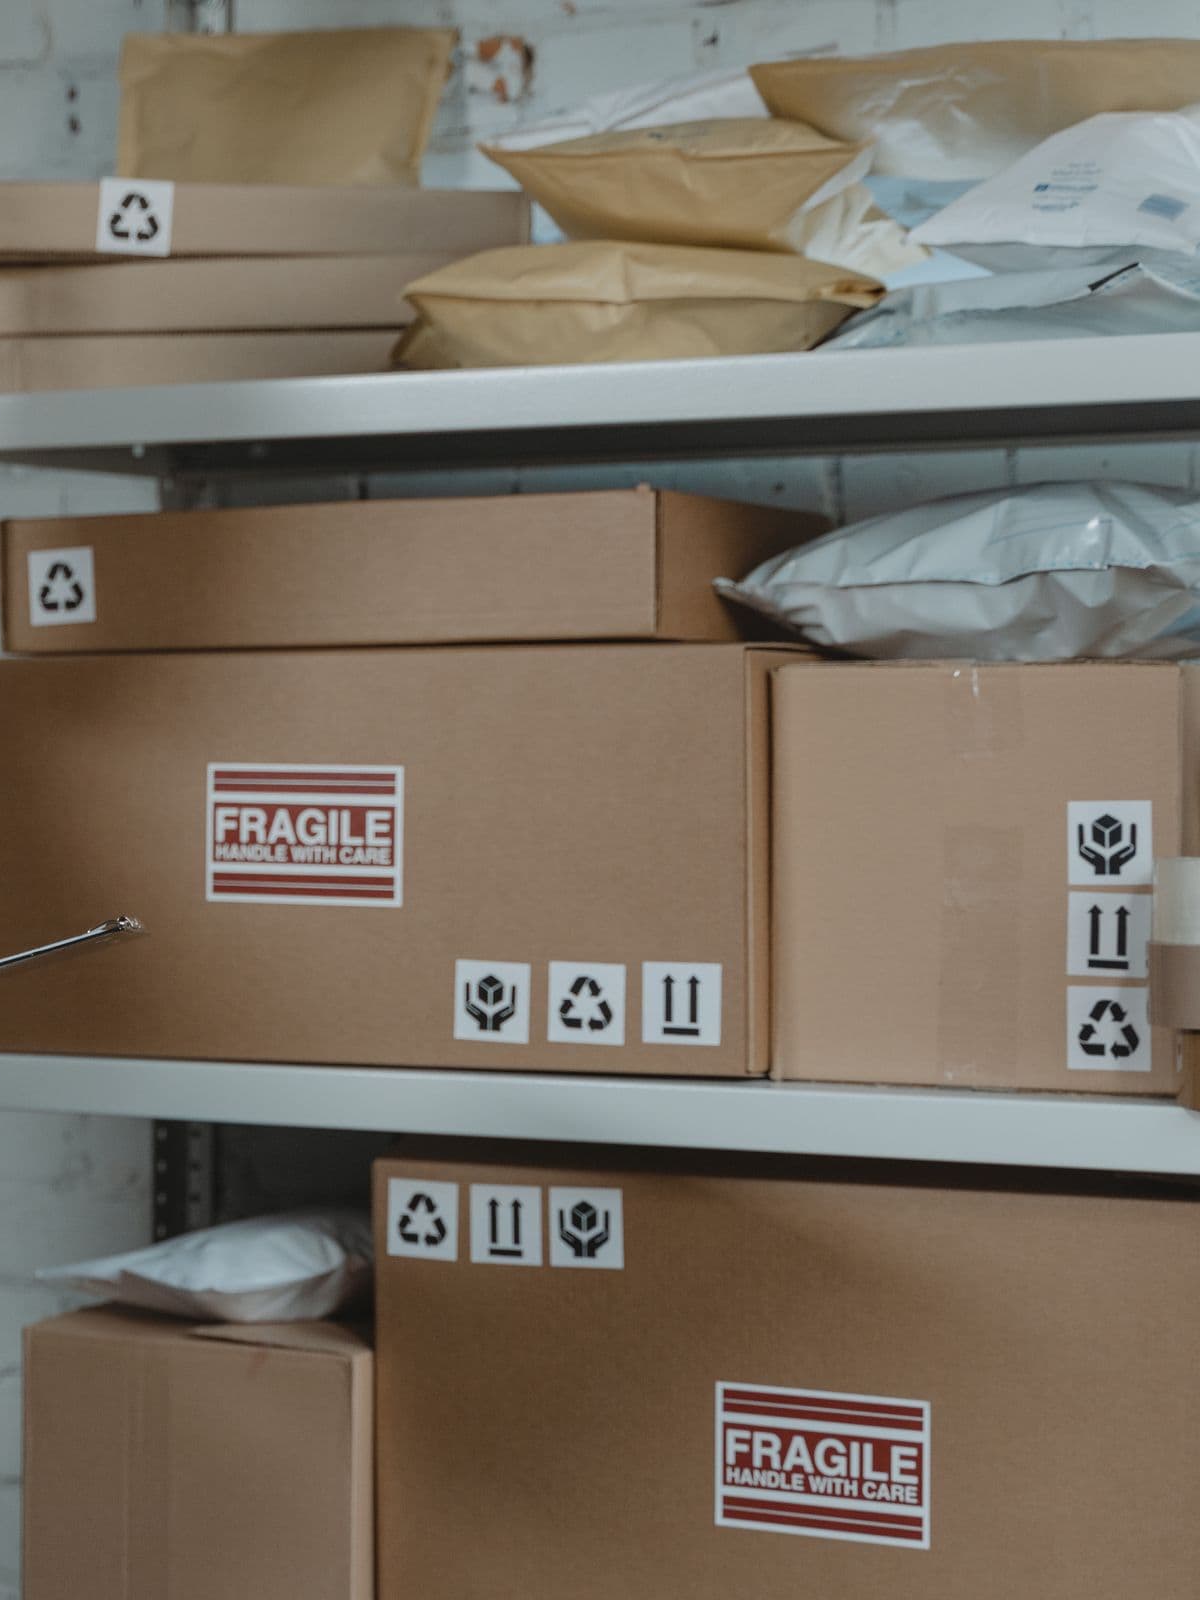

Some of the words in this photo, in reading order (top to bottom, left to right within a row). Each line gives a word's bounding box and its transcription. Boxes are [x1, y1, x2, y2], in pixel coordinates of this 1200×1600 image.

[215, 807, 392, 846] FRAGILE
[215, 843, 288, 862] HANDLE
[290, 845, 337, 864] WITH
[339, 847, 391, 865] CARE
[725, 1429, 918, 1485] FRAGILE
[726, 1466, 804, 1491] HANDLE
[808, 1475, 858, 1497] WITH
[862, 1482, 918, 1503] CARE
